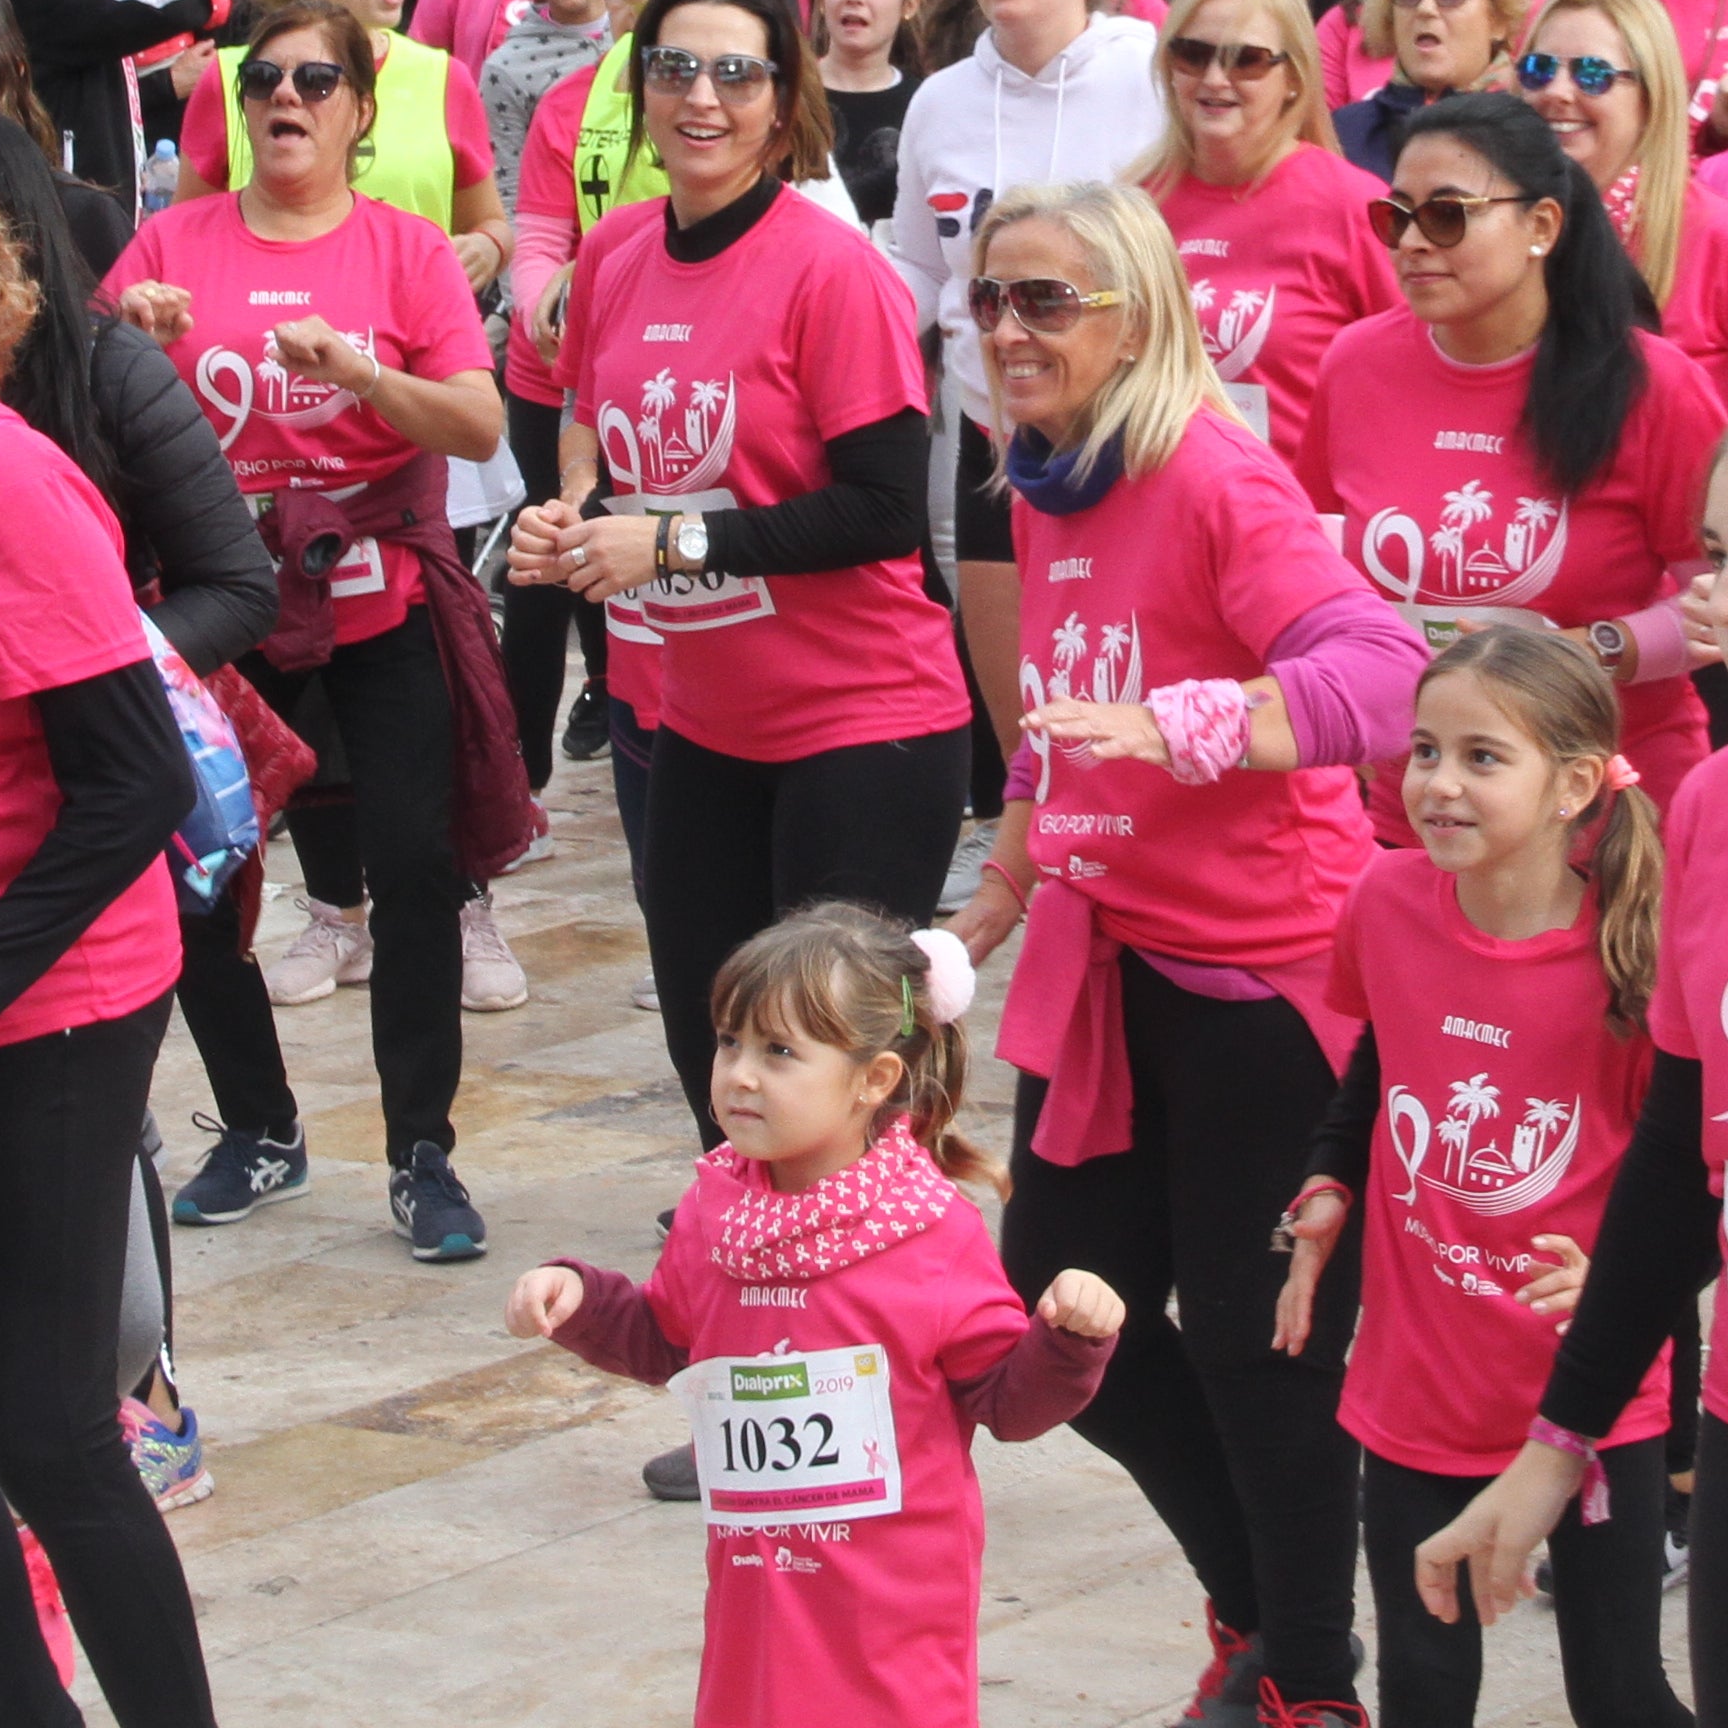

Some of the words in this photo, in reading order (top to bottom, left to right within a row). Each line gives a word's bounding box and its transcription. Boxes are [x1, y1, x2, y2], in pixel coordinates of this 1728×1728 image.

[248, 290, 312, 306] AMACMEC
[642, 323, 694, 343] AMACMEC
[1433, 430, 1505, 455] AMACMEC
[1440, 1014, 1513, 1049] AMACMEC
[1438, 1242, 1480, 1265] POR
[739, 1285, 808, 1310] AMACMEC
[733, 1372, 805, 1396] Dialprix
[814, 1375, 855, 1396] 2019
[719, 1413, 841, 1473] 1032
[799, 1523, 850, 1542] VIVIR
